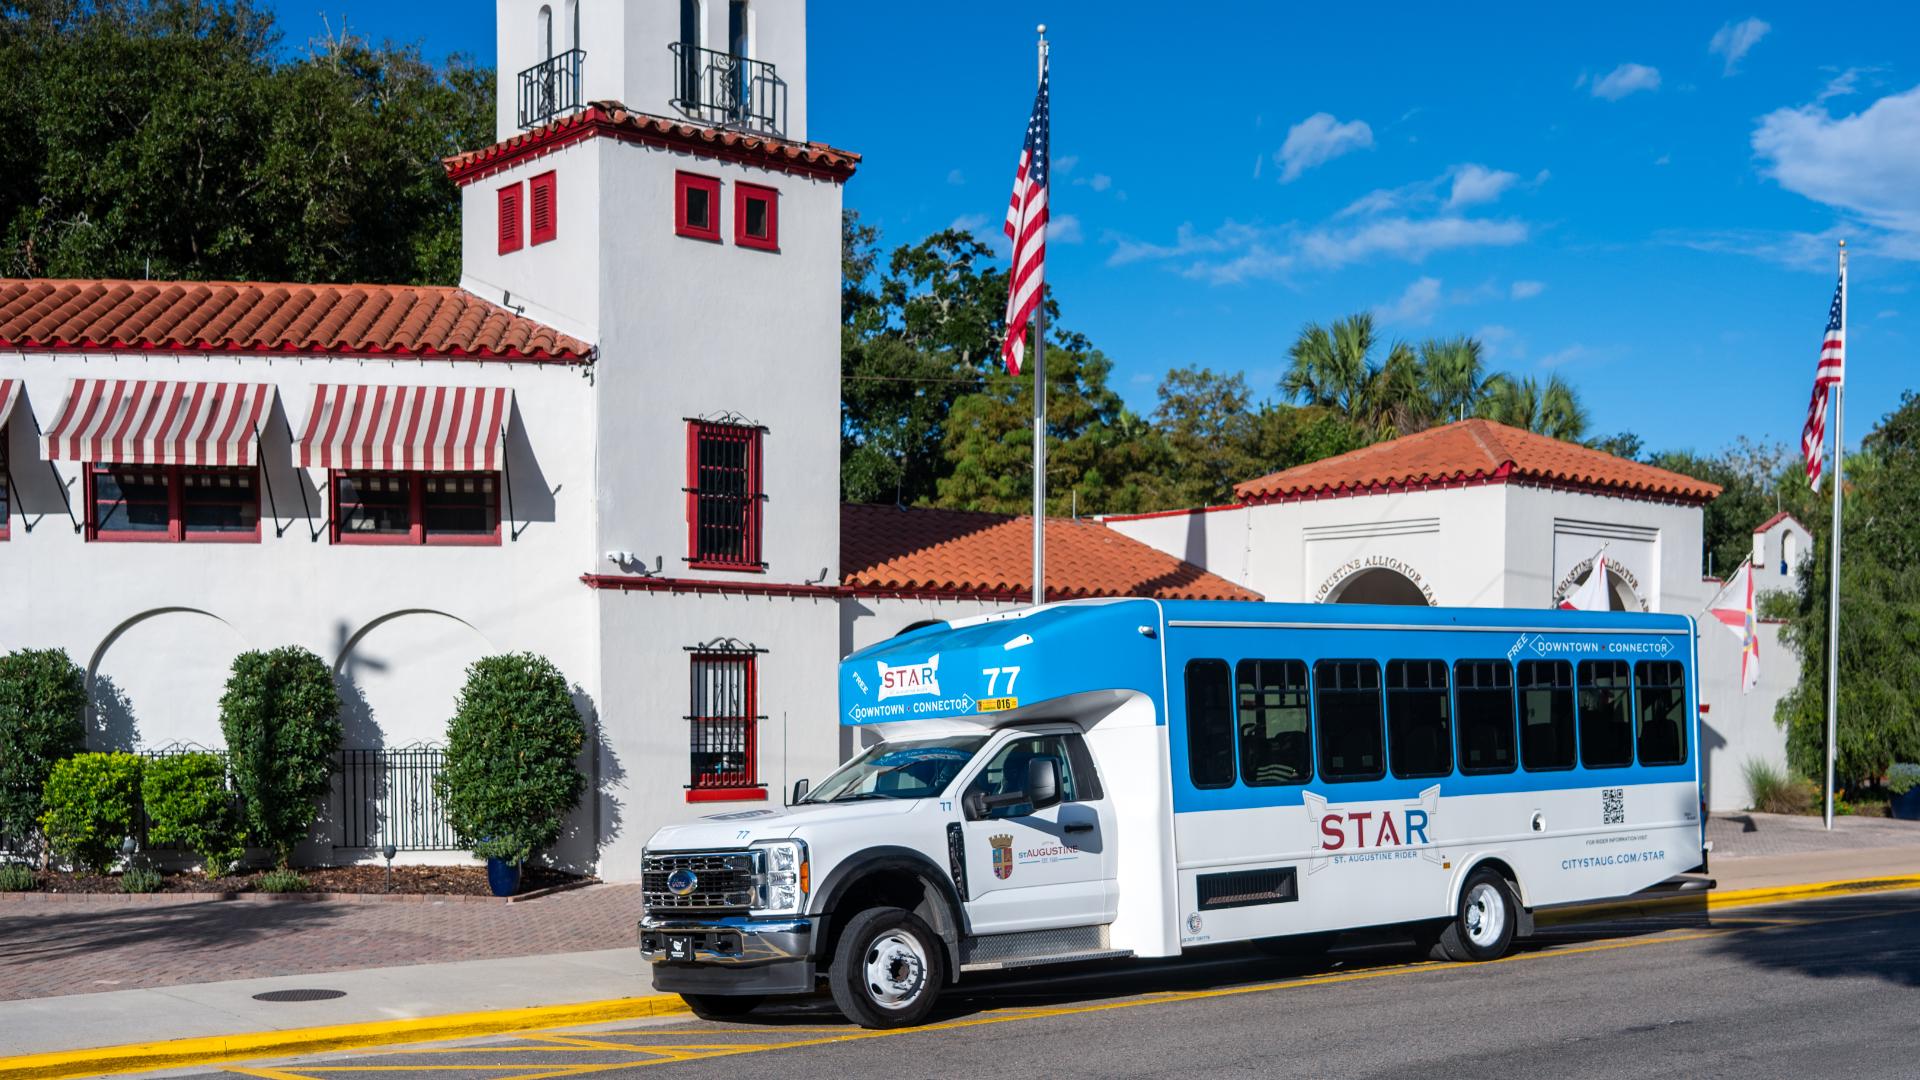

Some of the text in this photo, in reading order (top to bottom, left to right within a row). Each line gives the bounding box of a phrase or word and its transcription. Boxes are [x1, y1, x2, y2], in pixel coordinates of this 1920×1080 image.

[1364, 555, 1422, 585] ALLIGATOR
[1422, 583, 1438, 607] FAR
[1506, 633, 1529, 661] FREE
[1538, 641, 1667, 653] DOWNTOWN CONNECTOR
[852, 671, 869, 695] FREE
[884, 667, 933, 689] STAR
[982, 665, 1021, 696] 77
[855, 704, 905, 719] DOWNTOWN
[913, 698, 968, 714] CONNECTOR
[996, 698, 1011, 710] 016
[940, 802, 952, 811] 77
[736, 830, 751, 839] 77
[1320, 809, 1429, 851] STAR
[1334, 851, 1418, 864] ST. AUGUSTINE RIDER
[1561, 850, 1665, 870] CITYSTAUG.COM/STAR
